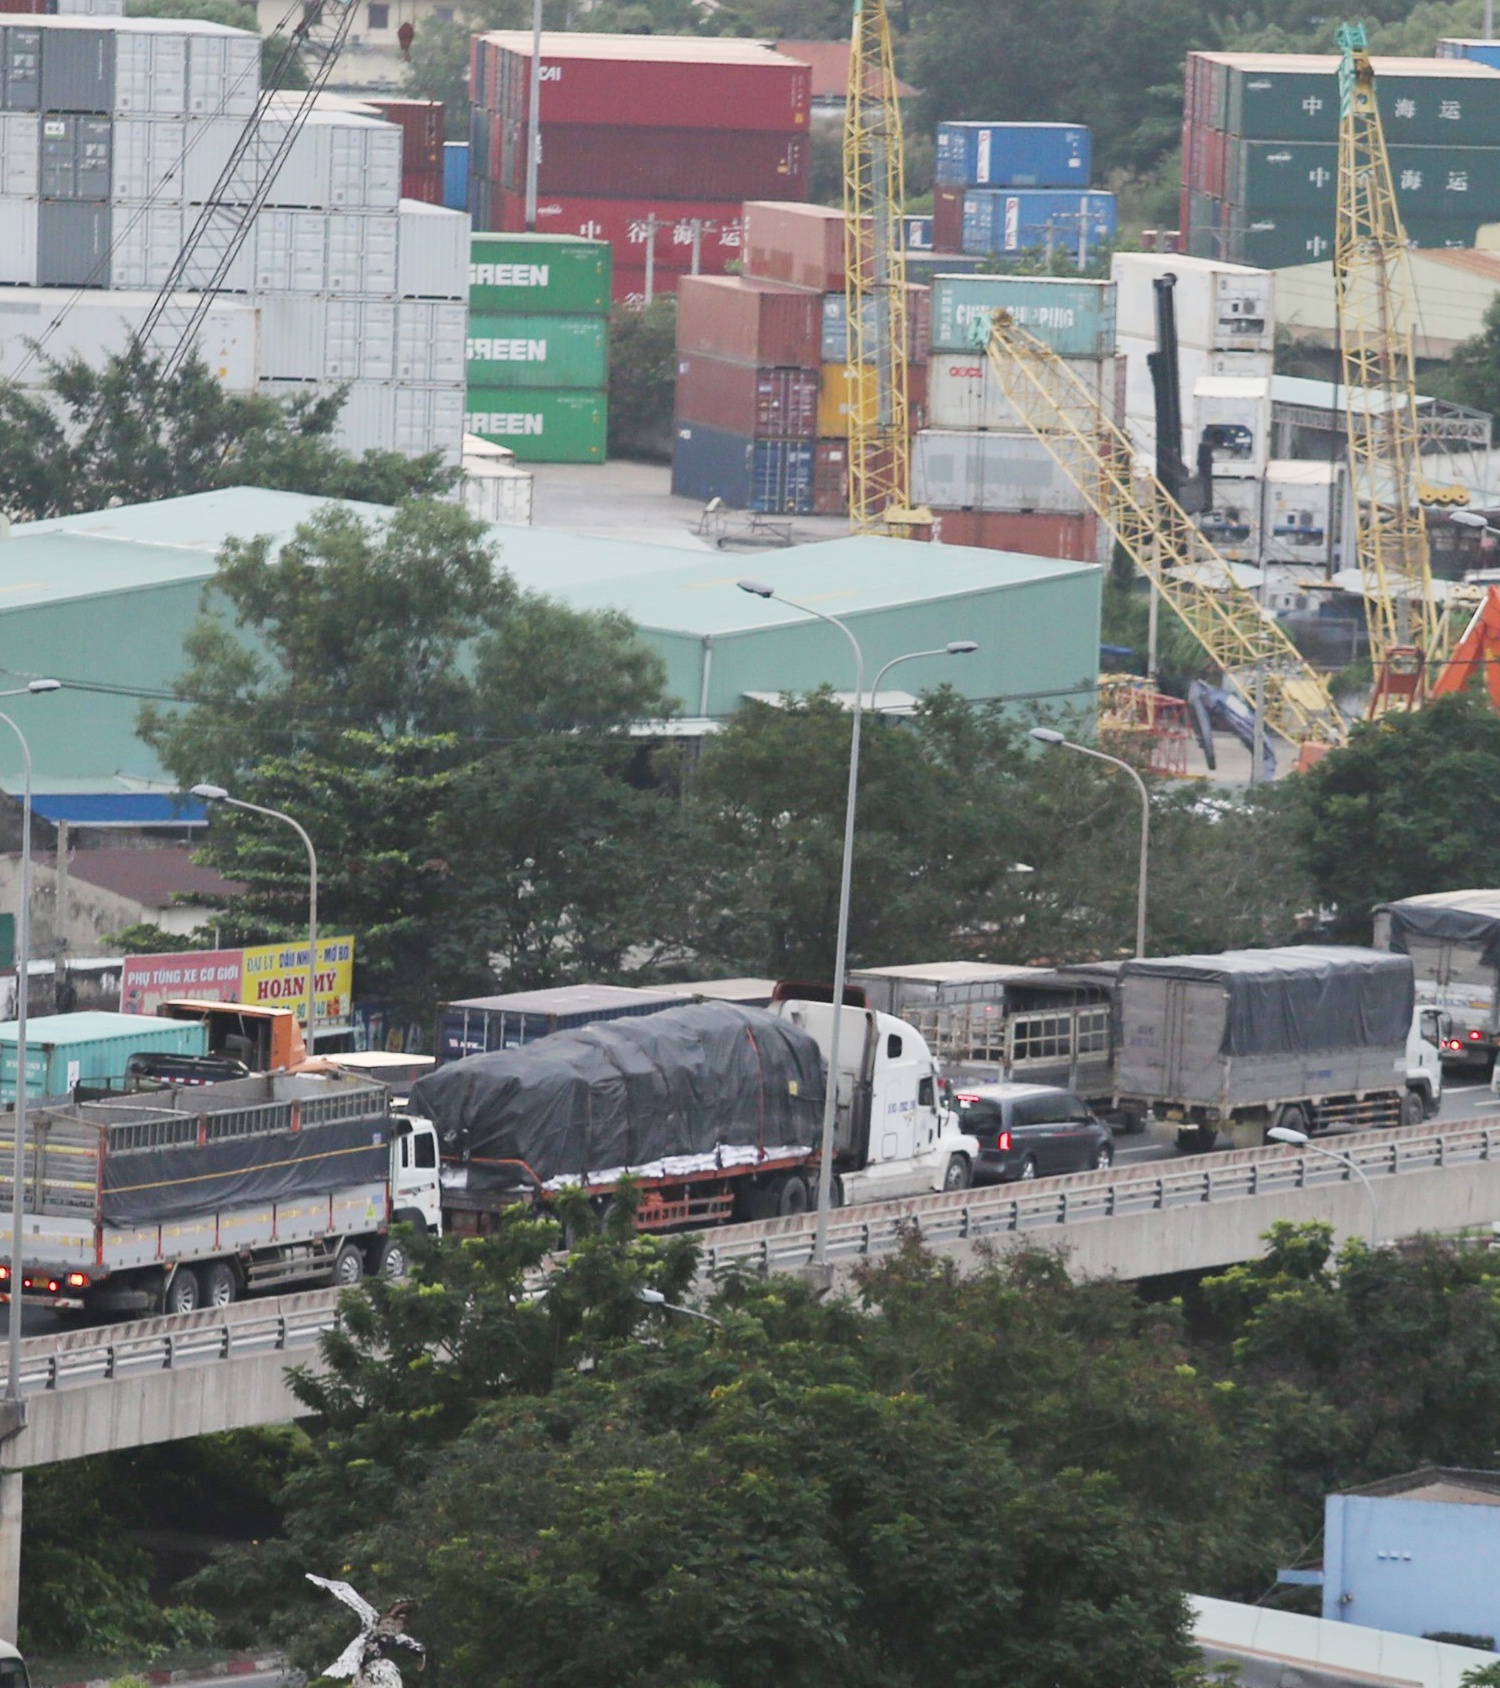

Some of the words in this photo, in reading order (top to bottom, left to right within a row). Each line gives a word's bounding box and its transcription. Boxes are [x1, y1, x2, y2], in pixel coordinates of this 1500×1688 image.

[1303, 96, 1461, 119] 中海运
[128, 970, 149, 987] PHỤ
[152, 967, 181, 985] TÙNG
[183, 969, 197, 982] XE
[200, 967, 215, 981] CƠ
[217, 963, 239, 980] GIỚI
[257, 973, 305, 1000] HOÀN
